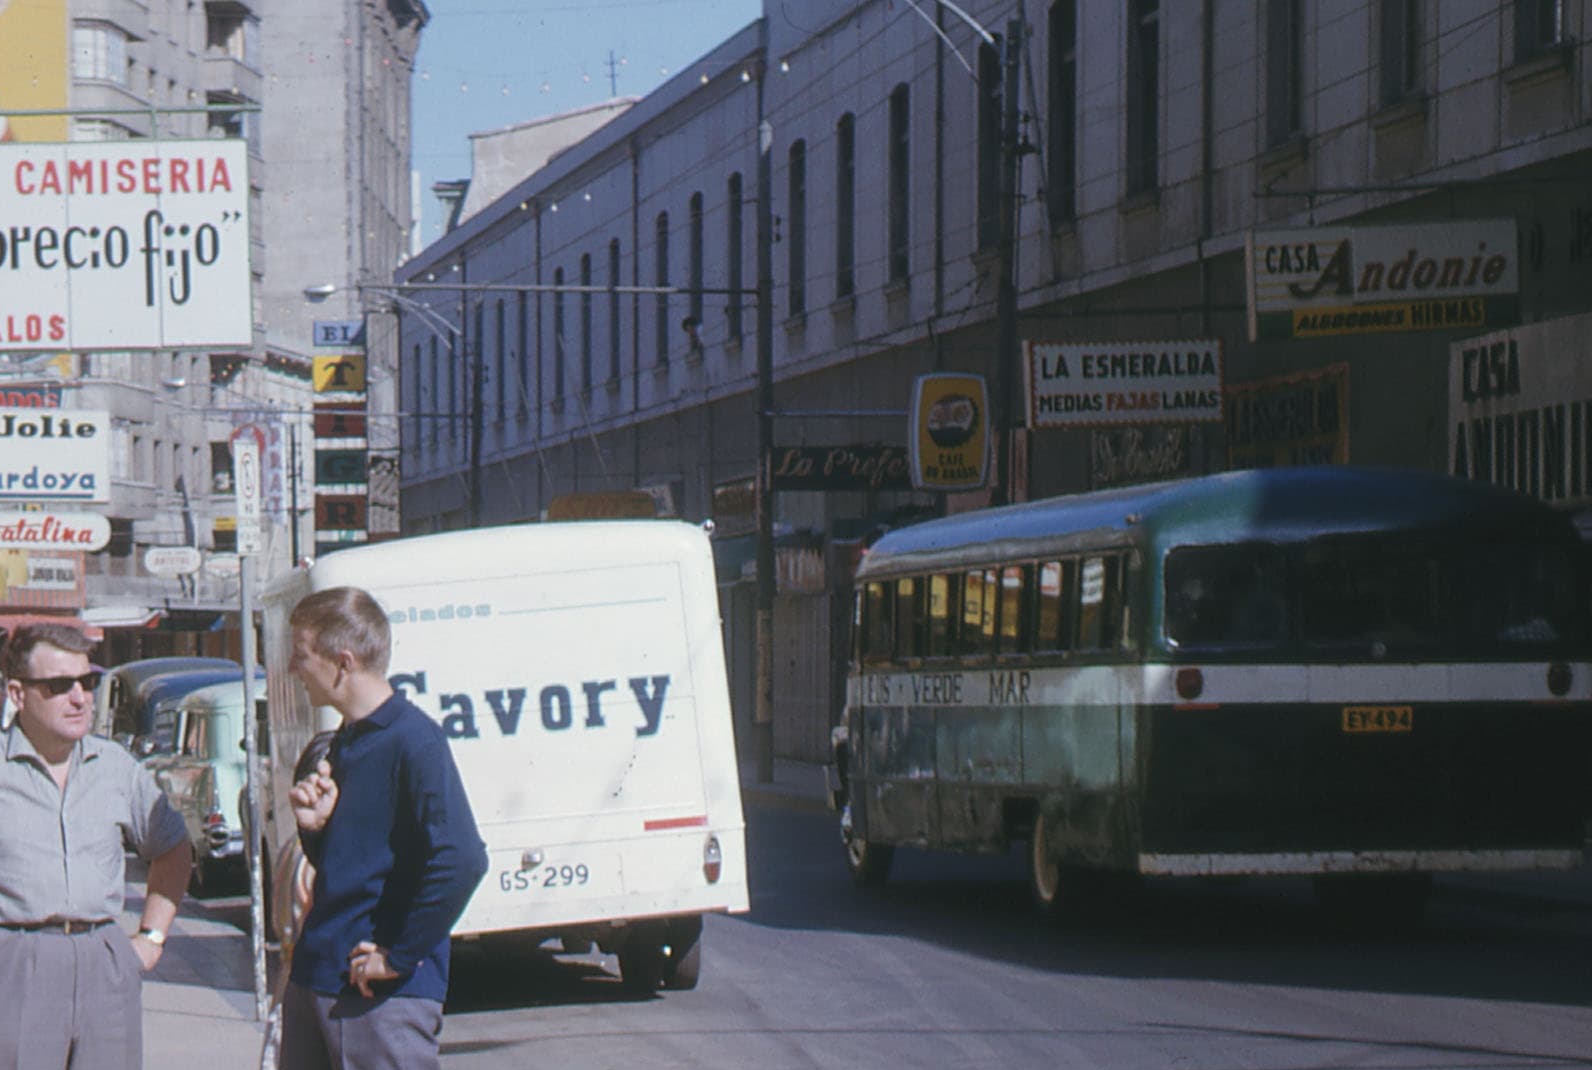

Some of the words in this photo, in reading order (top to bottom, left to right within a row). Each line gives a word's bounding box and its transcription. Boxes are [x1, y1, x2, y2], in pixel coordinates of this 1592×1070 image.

[15, 158, 231, 194] CAMISERIA
[1266, 243, 1320, 275] CASA
[1289, 238, 1507, 298] Andonie
[323, 326, 351, 341] EL
[1041, 355, 1069, 379] LA
[1082, 352, 1216, 378] ESMERALDA
[1462, 340, 1521, 402] CASA
[1039, 393, 1102, 412] MEDIAS
[1107, 391, 1159, 411] FAJAS
[1162, 391, 1218, 410] LANAS
[323, 361, 356, 525] TIGR
[775, 450, 813, 476] La
[389, 604, 491, 624] elados
[911, 673, 963, 704] VERDE
[989, 670, 1031, 704] MAR
